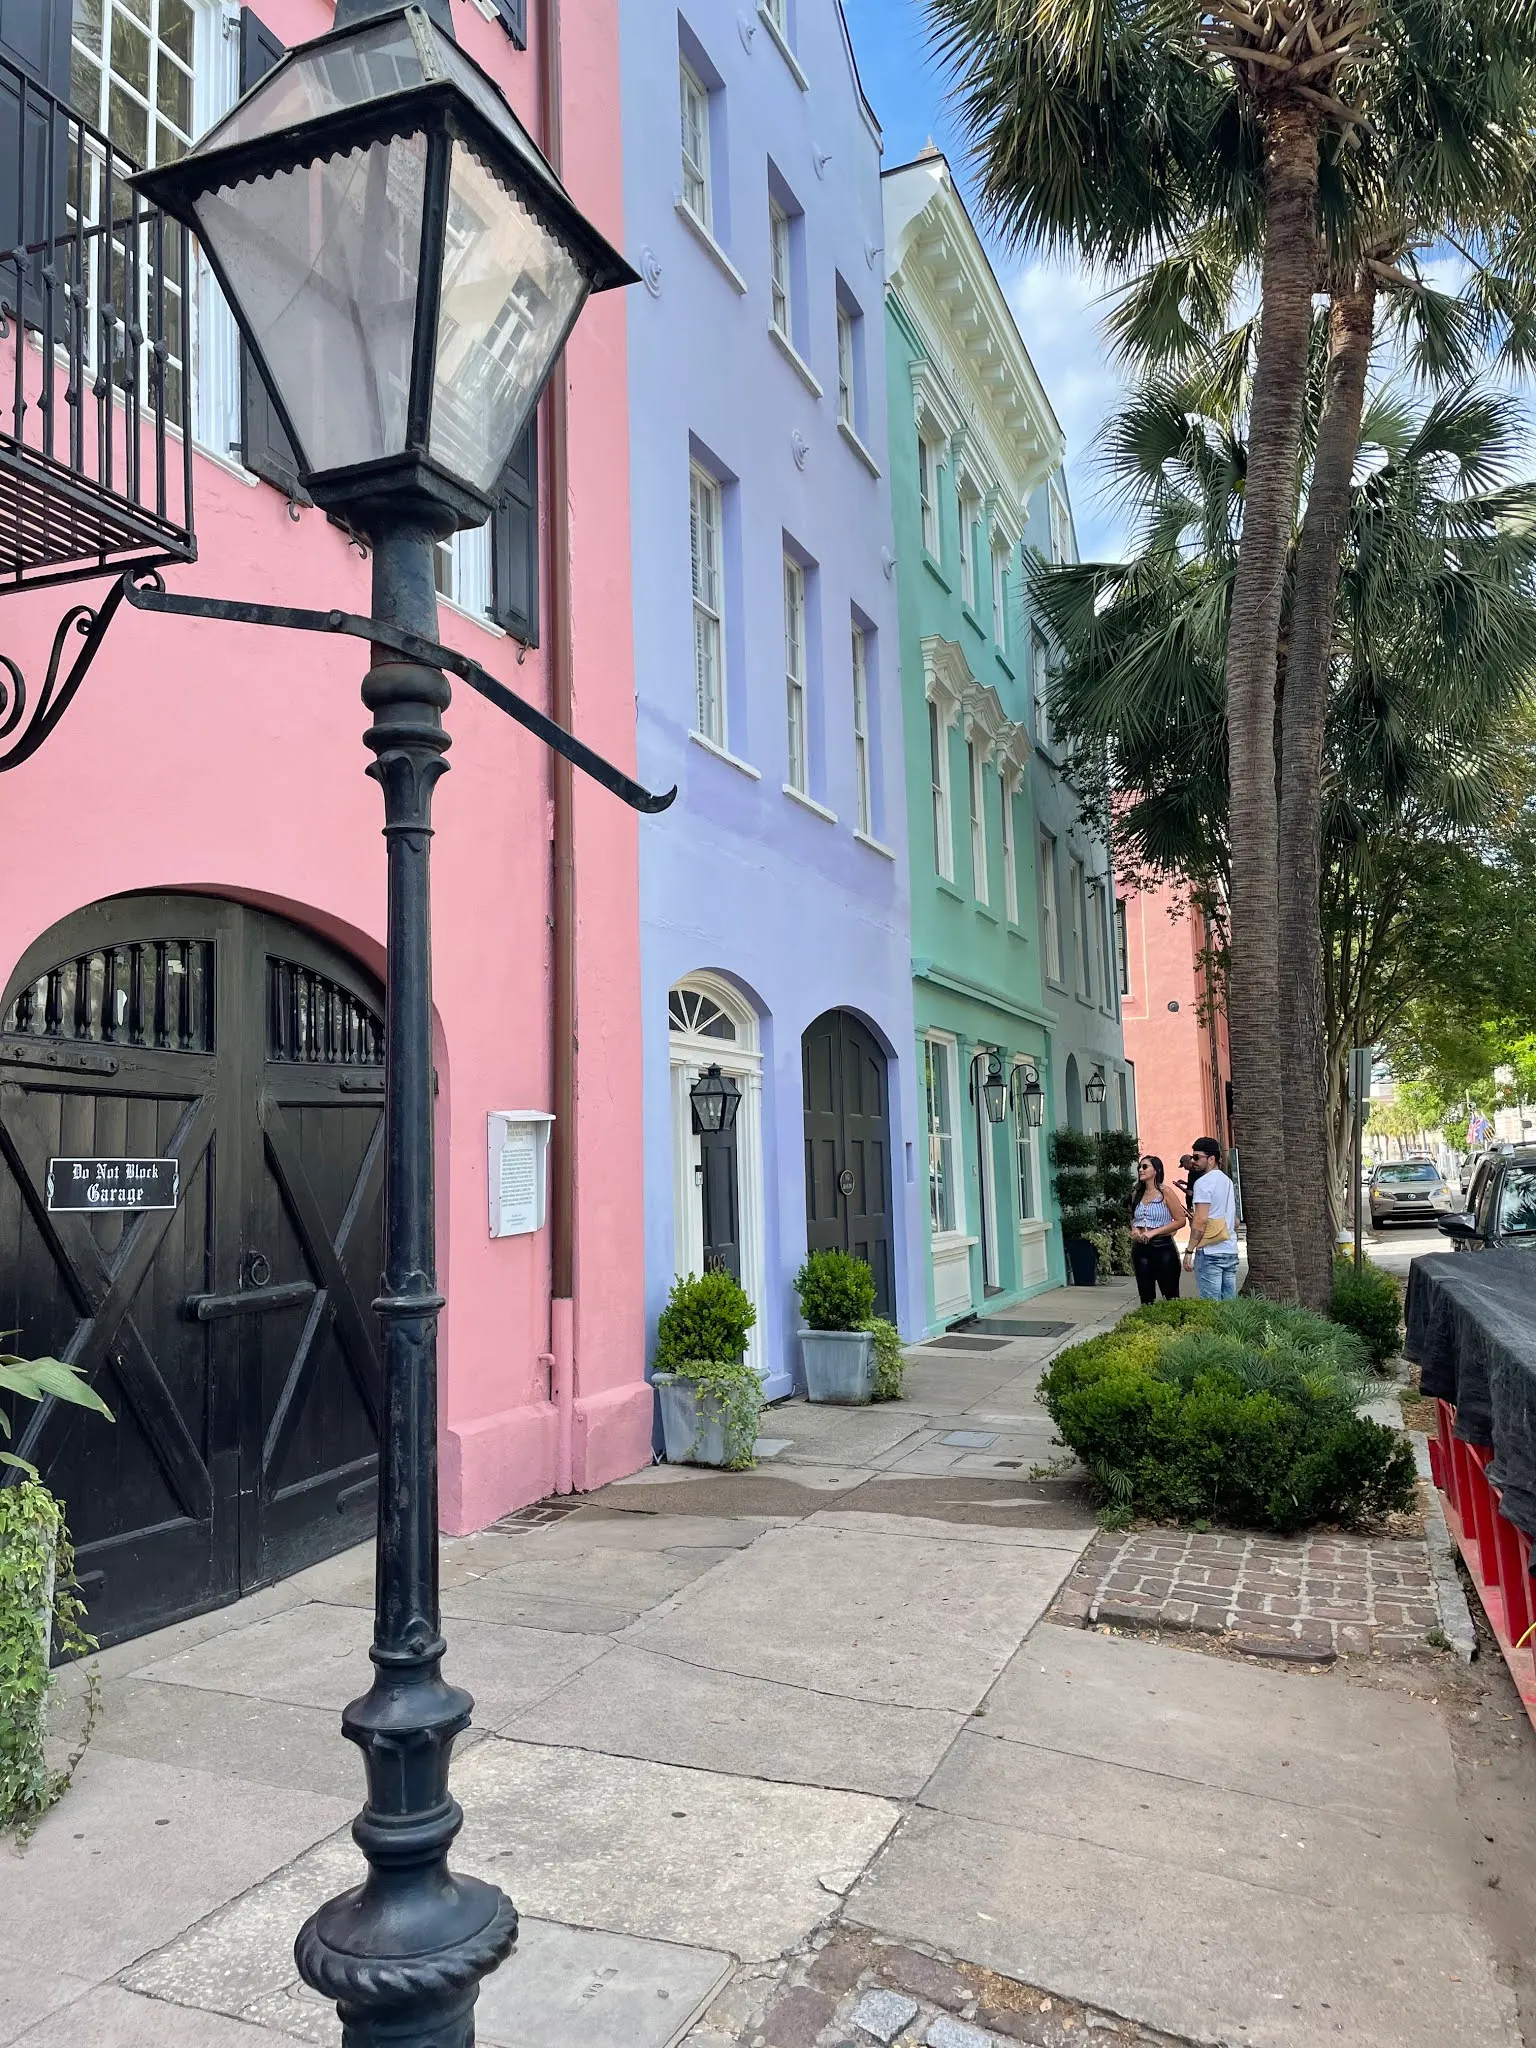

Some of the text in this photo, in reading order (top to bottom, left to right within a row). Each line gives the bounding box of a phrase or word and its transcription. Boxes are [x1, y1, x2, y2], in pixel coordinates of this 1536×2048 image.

[72, 1162, 159, 1180] Do Not Block
[86, 1182, 144, 1205] Garage
[708, 1253, 727, 1273] 103
